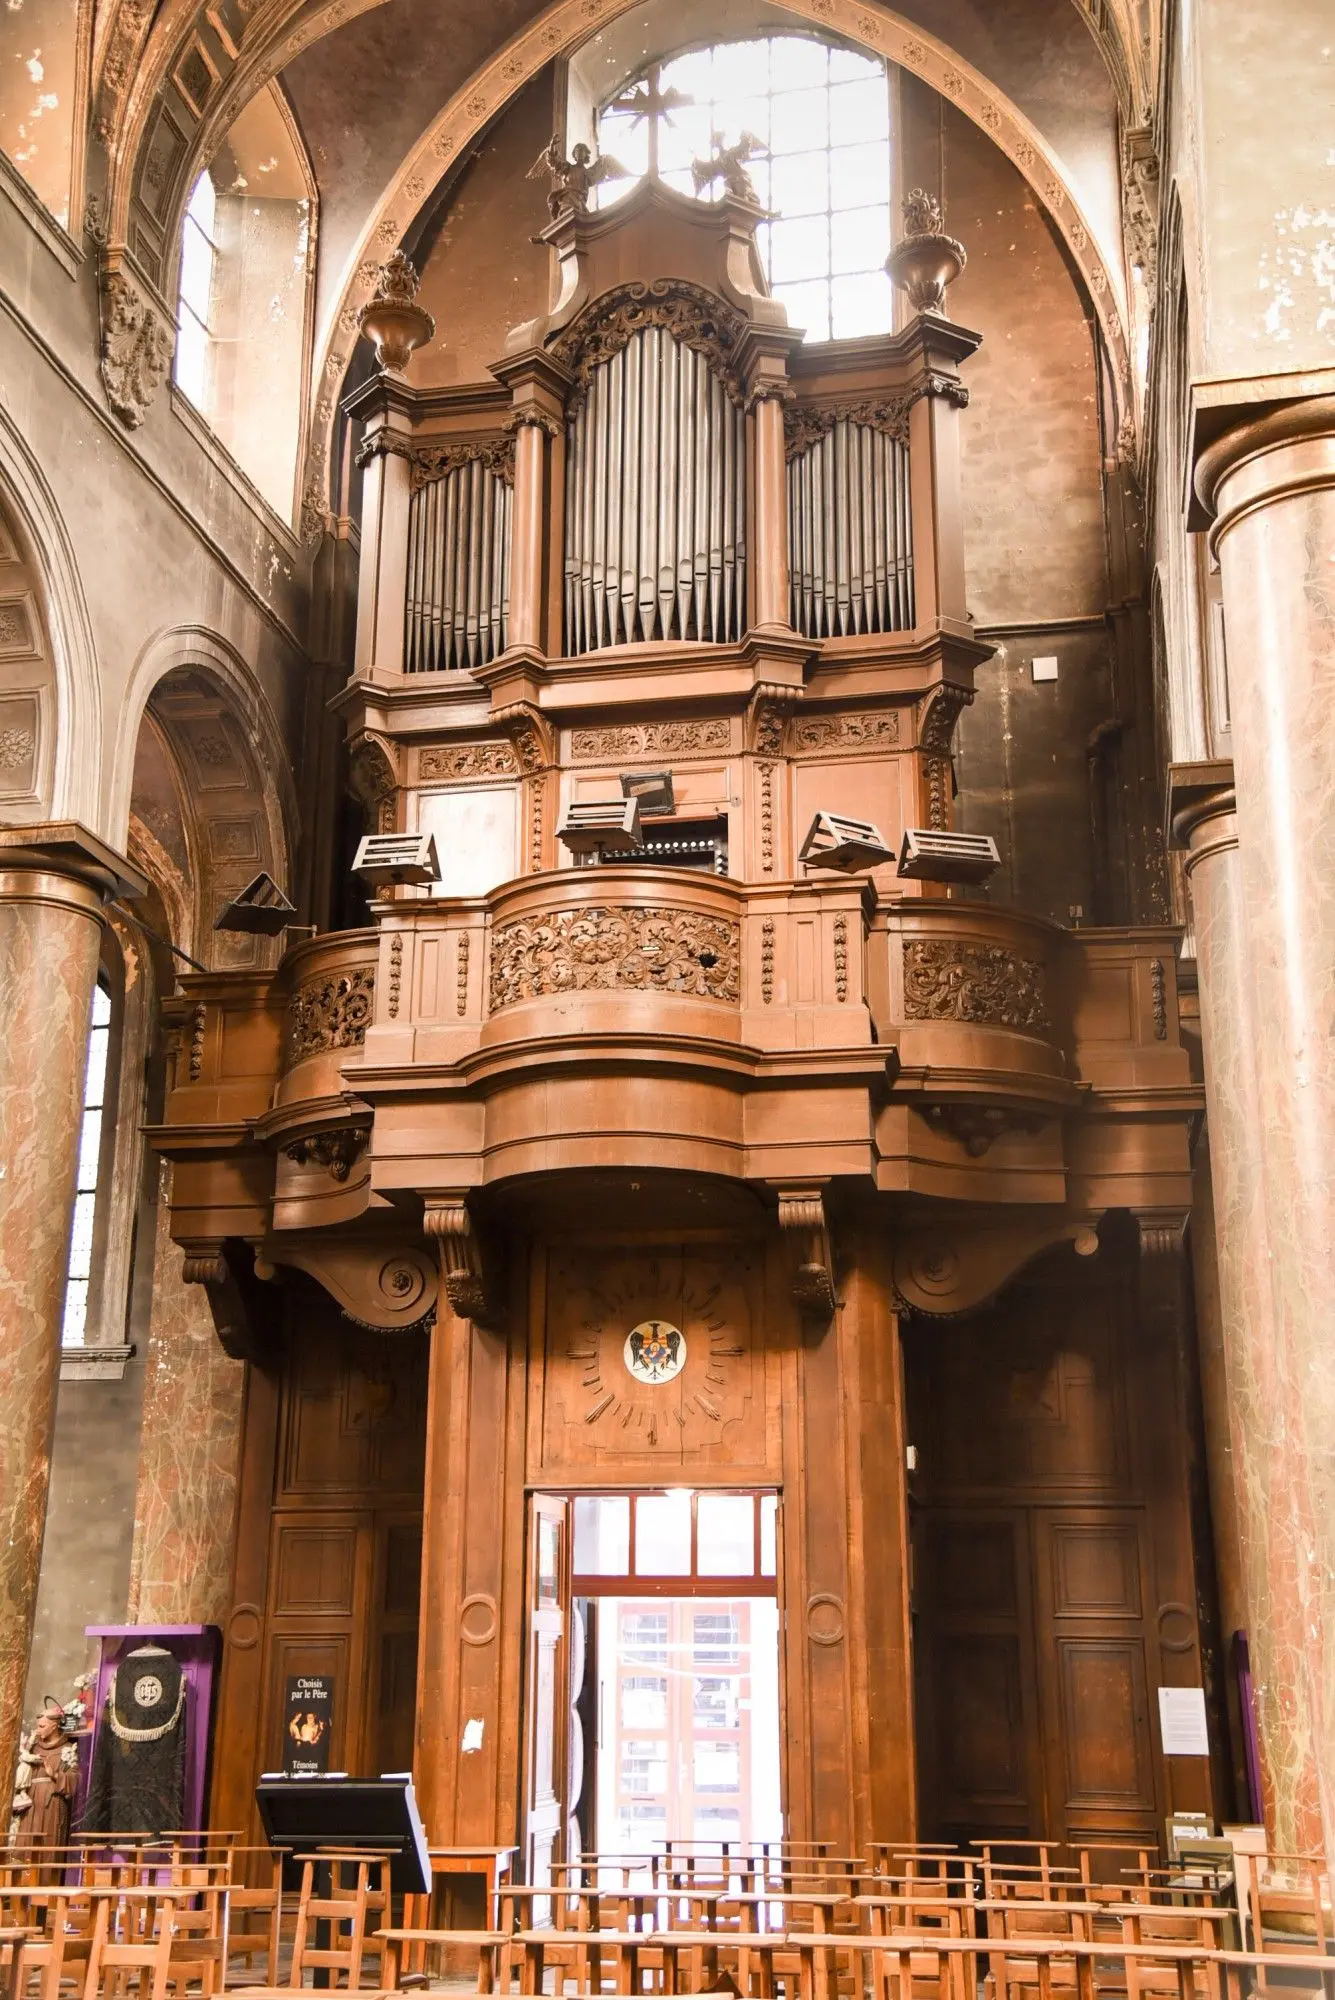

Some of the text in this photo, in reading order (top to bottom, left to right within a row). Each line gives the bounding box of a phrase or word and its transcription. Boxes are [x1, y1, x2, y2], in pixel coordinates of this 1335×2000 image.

[297, 1679, 323, 1688] Choisis
[291, 1689, 328, 1701] par le Père
